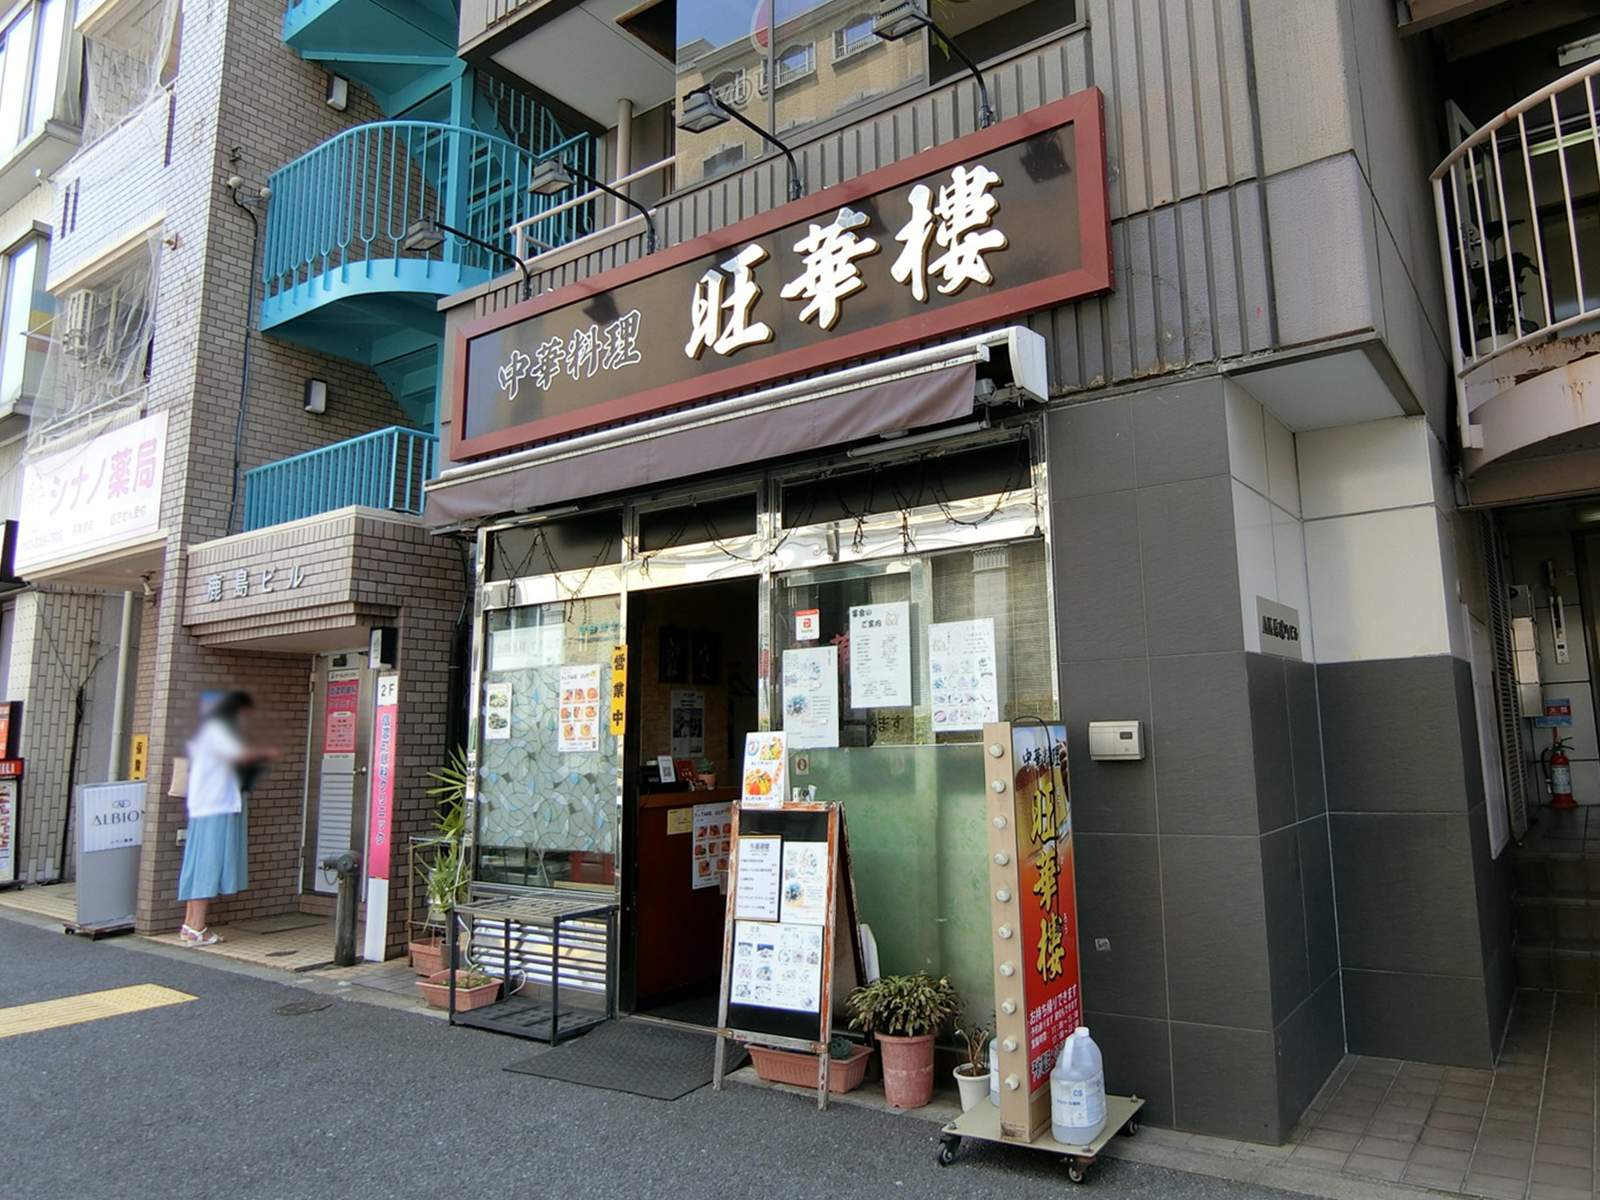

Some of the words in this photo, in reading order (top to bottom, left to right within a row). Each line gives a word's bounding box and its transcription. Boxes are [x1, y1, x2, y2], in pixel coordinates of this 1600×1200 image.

[686, 165, 1008, 360] 旺華樓
[497, 309, 642, 400] 中華料理
[49, 437, 158, 516] シナノ薬局
[206, 565, 305, 602] 鹿島ビル
[381, 683, 395, 698] 2F
[613, 653, 626, 727] 営業中
[1030, 779, 1066, 983] 旺華樓
